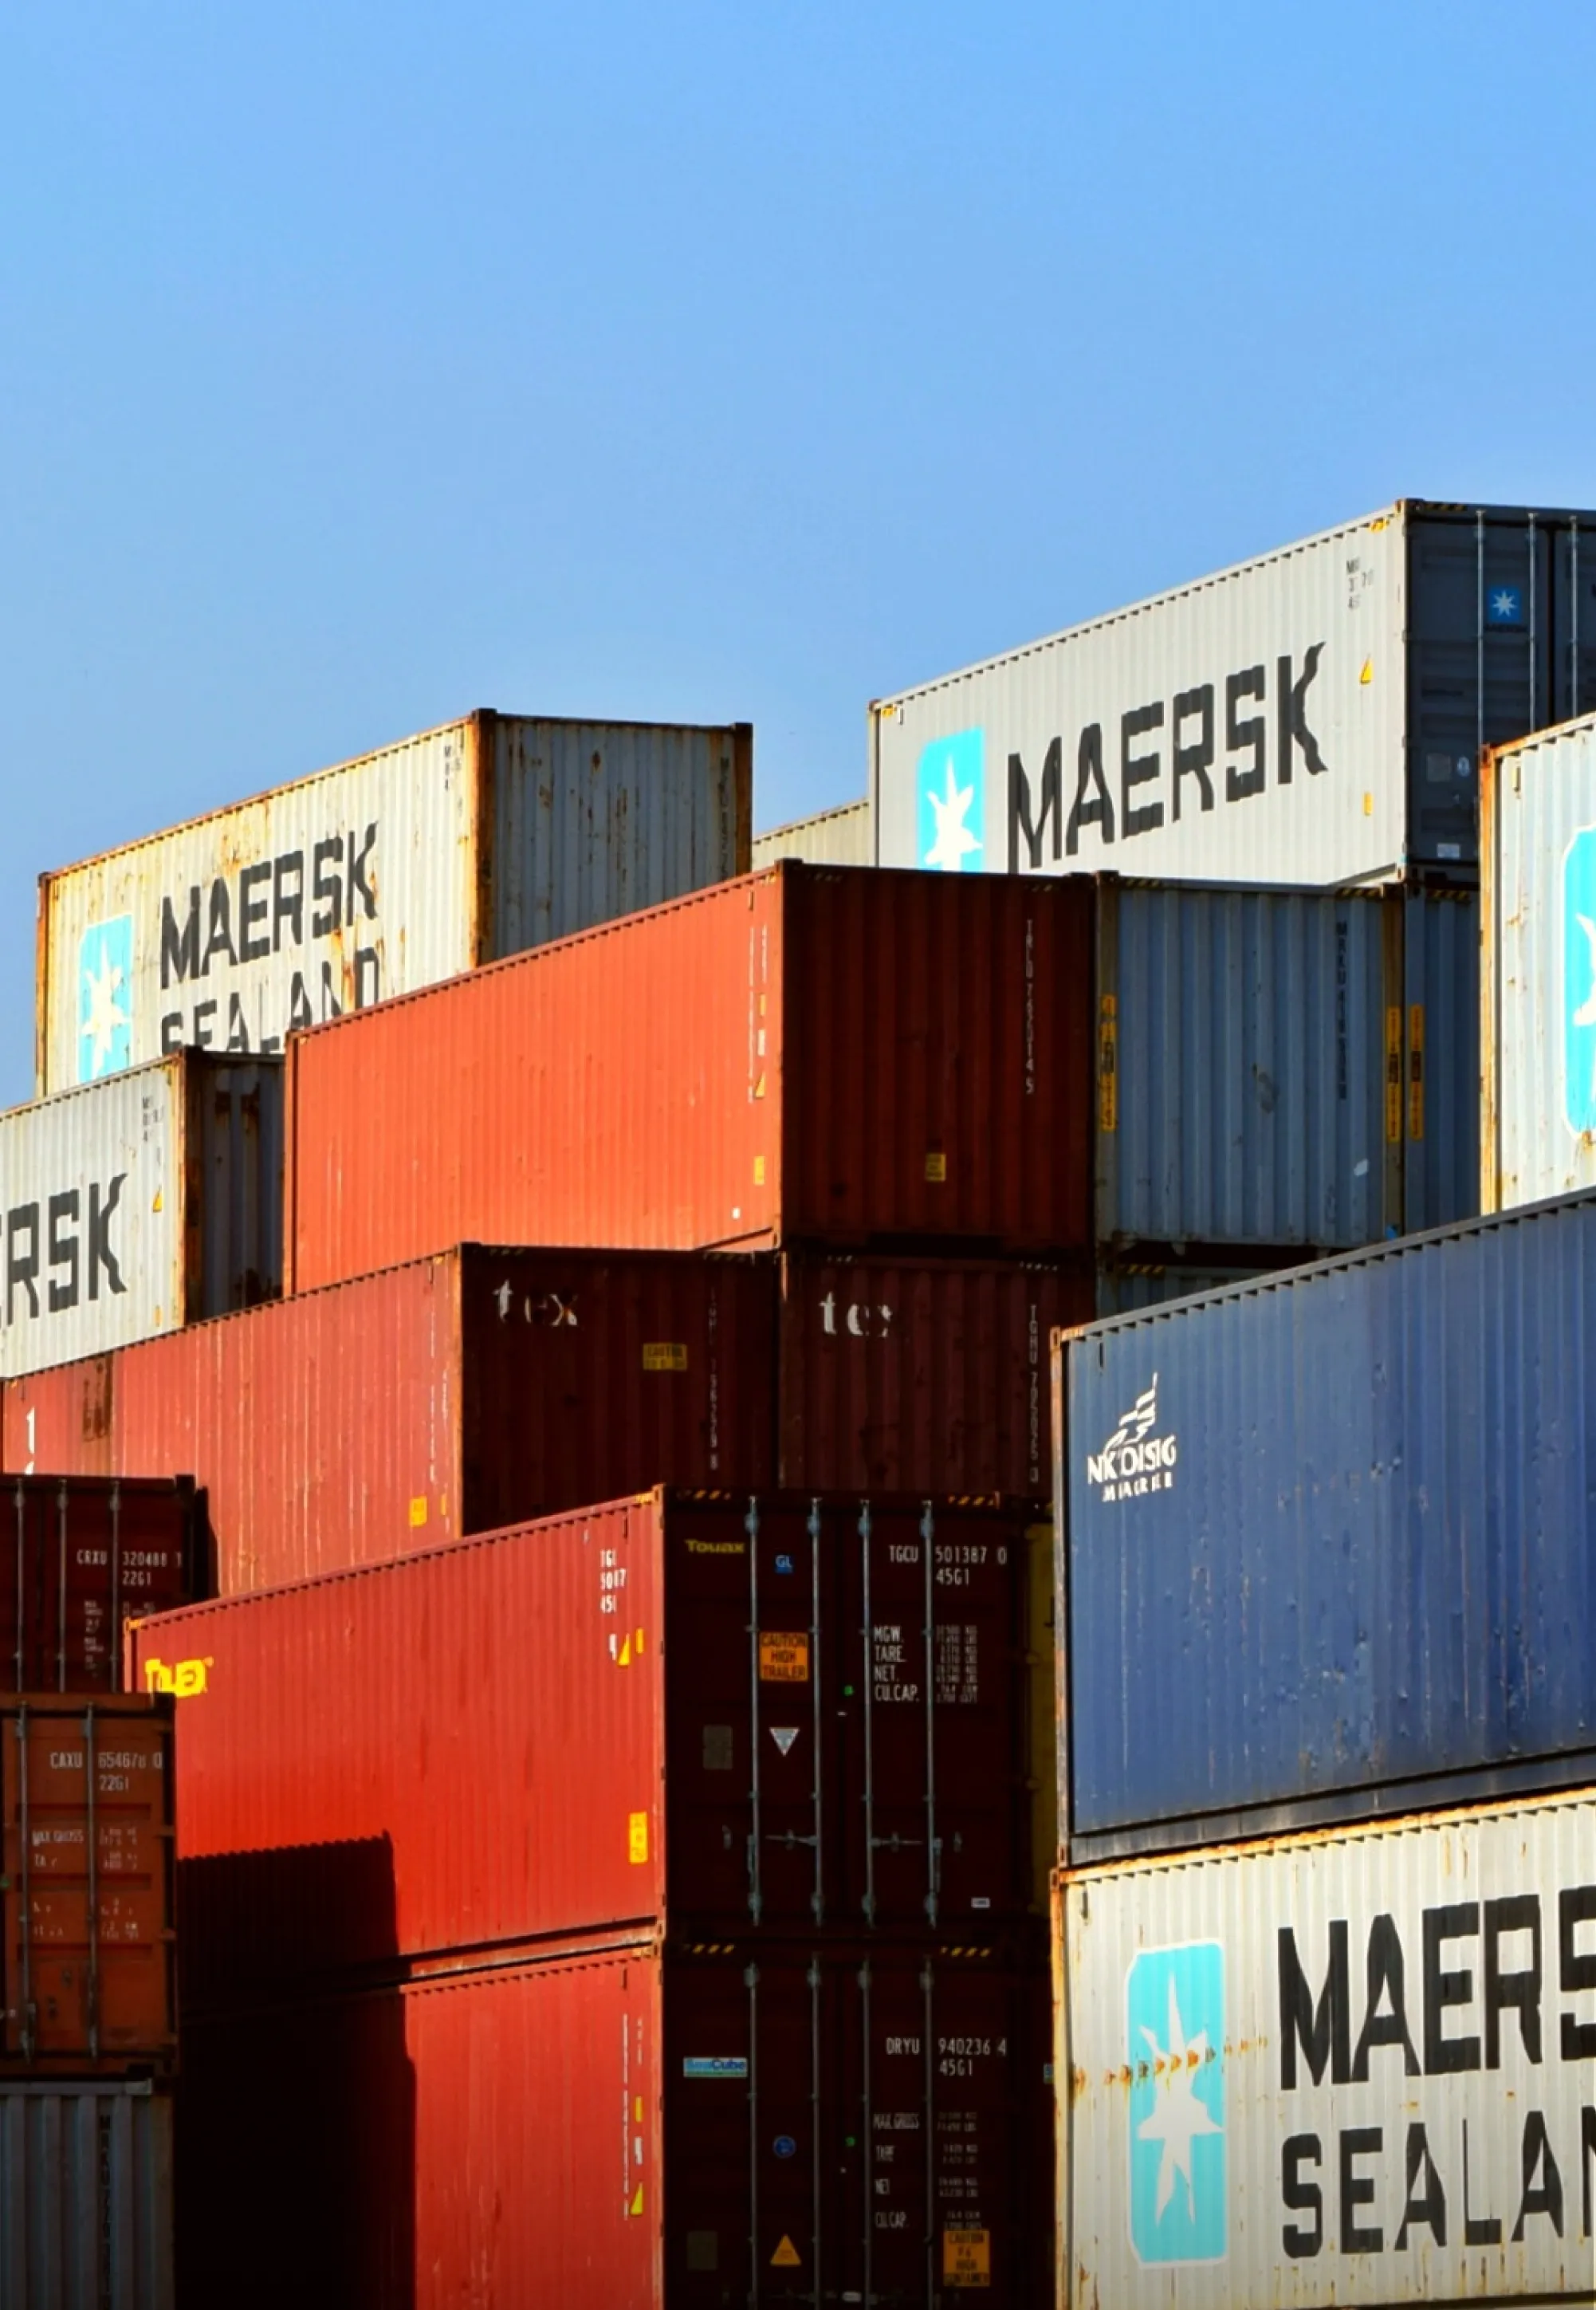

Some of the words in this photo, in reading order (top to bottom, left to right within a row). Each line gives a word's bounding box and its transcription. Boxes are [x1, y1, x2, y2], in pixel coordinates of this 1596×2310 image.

[1008, 641, 1328, 876] MAERSK
[161, 821, 378, 990] MAERSK
[0, 1173, 128, 1329] RSK
[889, 1545, 919, 1563] TGCU
[935, 1545, 988, 1564] 501387
[997, 1545, 1008, 1565] 0
[935, 1567, 970, 1586] 45G1
[938, 2036, 992, 2056] 940236
[997, 2037, 1008, 2057] 4
